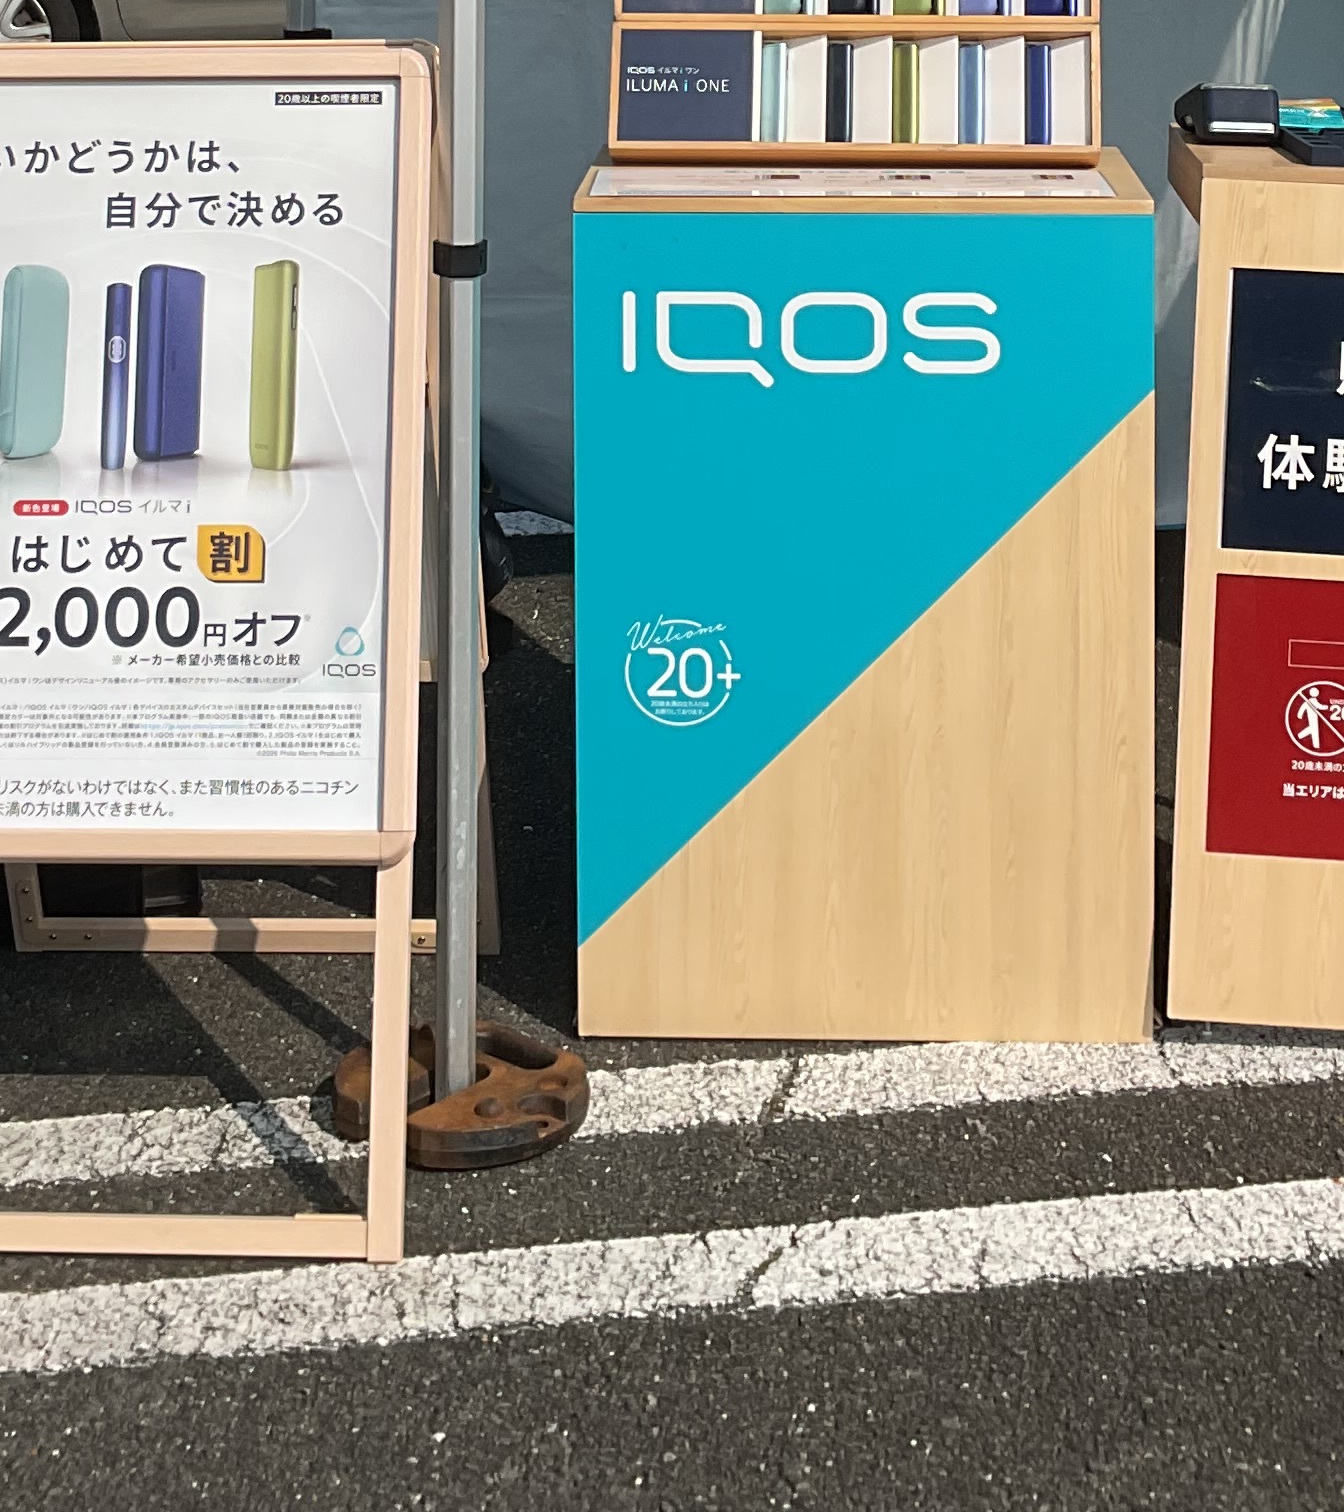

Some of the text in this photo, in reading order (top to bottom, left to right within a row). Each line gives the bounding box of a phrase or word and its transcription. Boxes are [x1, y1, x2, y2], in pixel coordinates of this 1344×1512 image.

[626, 78, 679, 92] ILUMA
[696, 78, 730, 92] ONE
[106, 192, 345, 229] 自分で決める
[622, 291, 1001, 388] IQOS
[75, 499, 133, 515] IQOS
[626, 614, 727, 651] Welcome
[323, 663, 376, 678] IQOS
